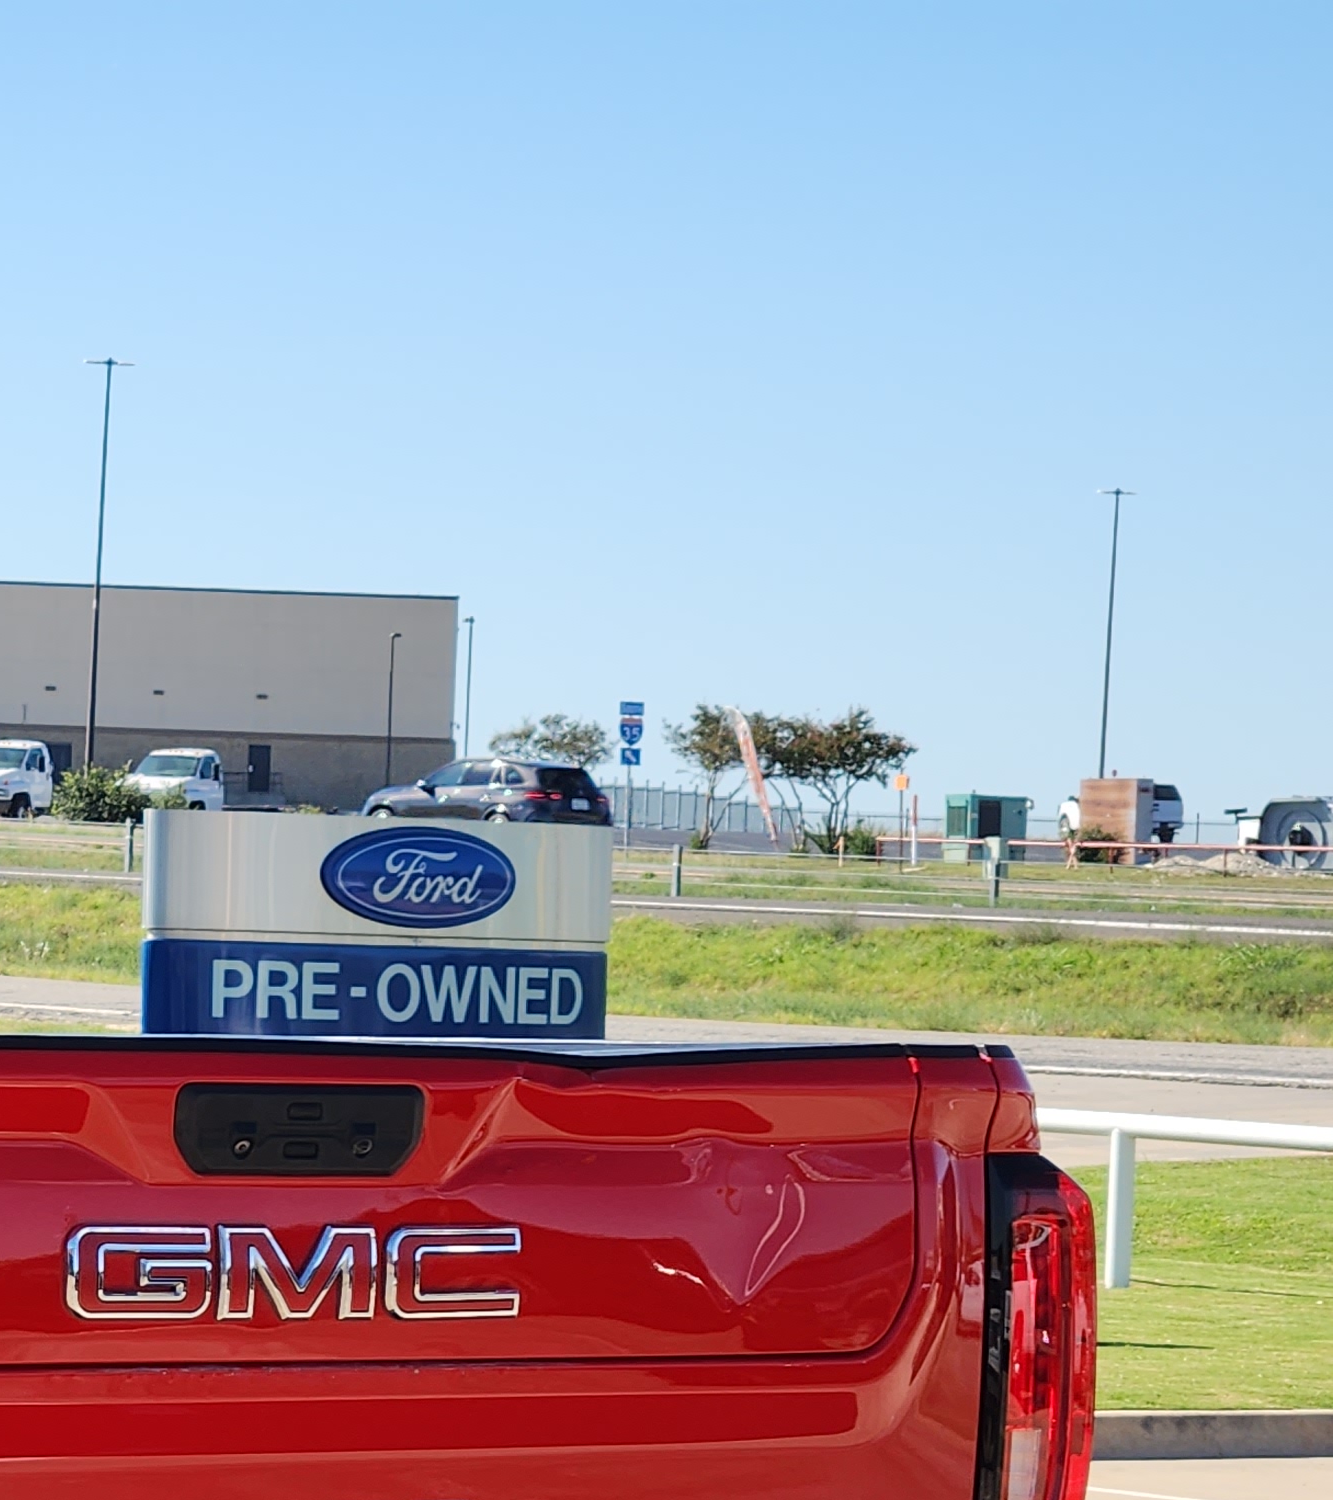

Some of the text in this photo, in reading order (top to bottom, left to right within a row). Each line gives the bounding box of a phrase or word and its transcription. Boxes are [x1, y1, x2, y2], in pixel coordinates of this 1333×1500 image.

[622, 726, 641, 742] 35
[372, 847, 484, 907] Ford
[65, 1224, 523, 1321] GMC
